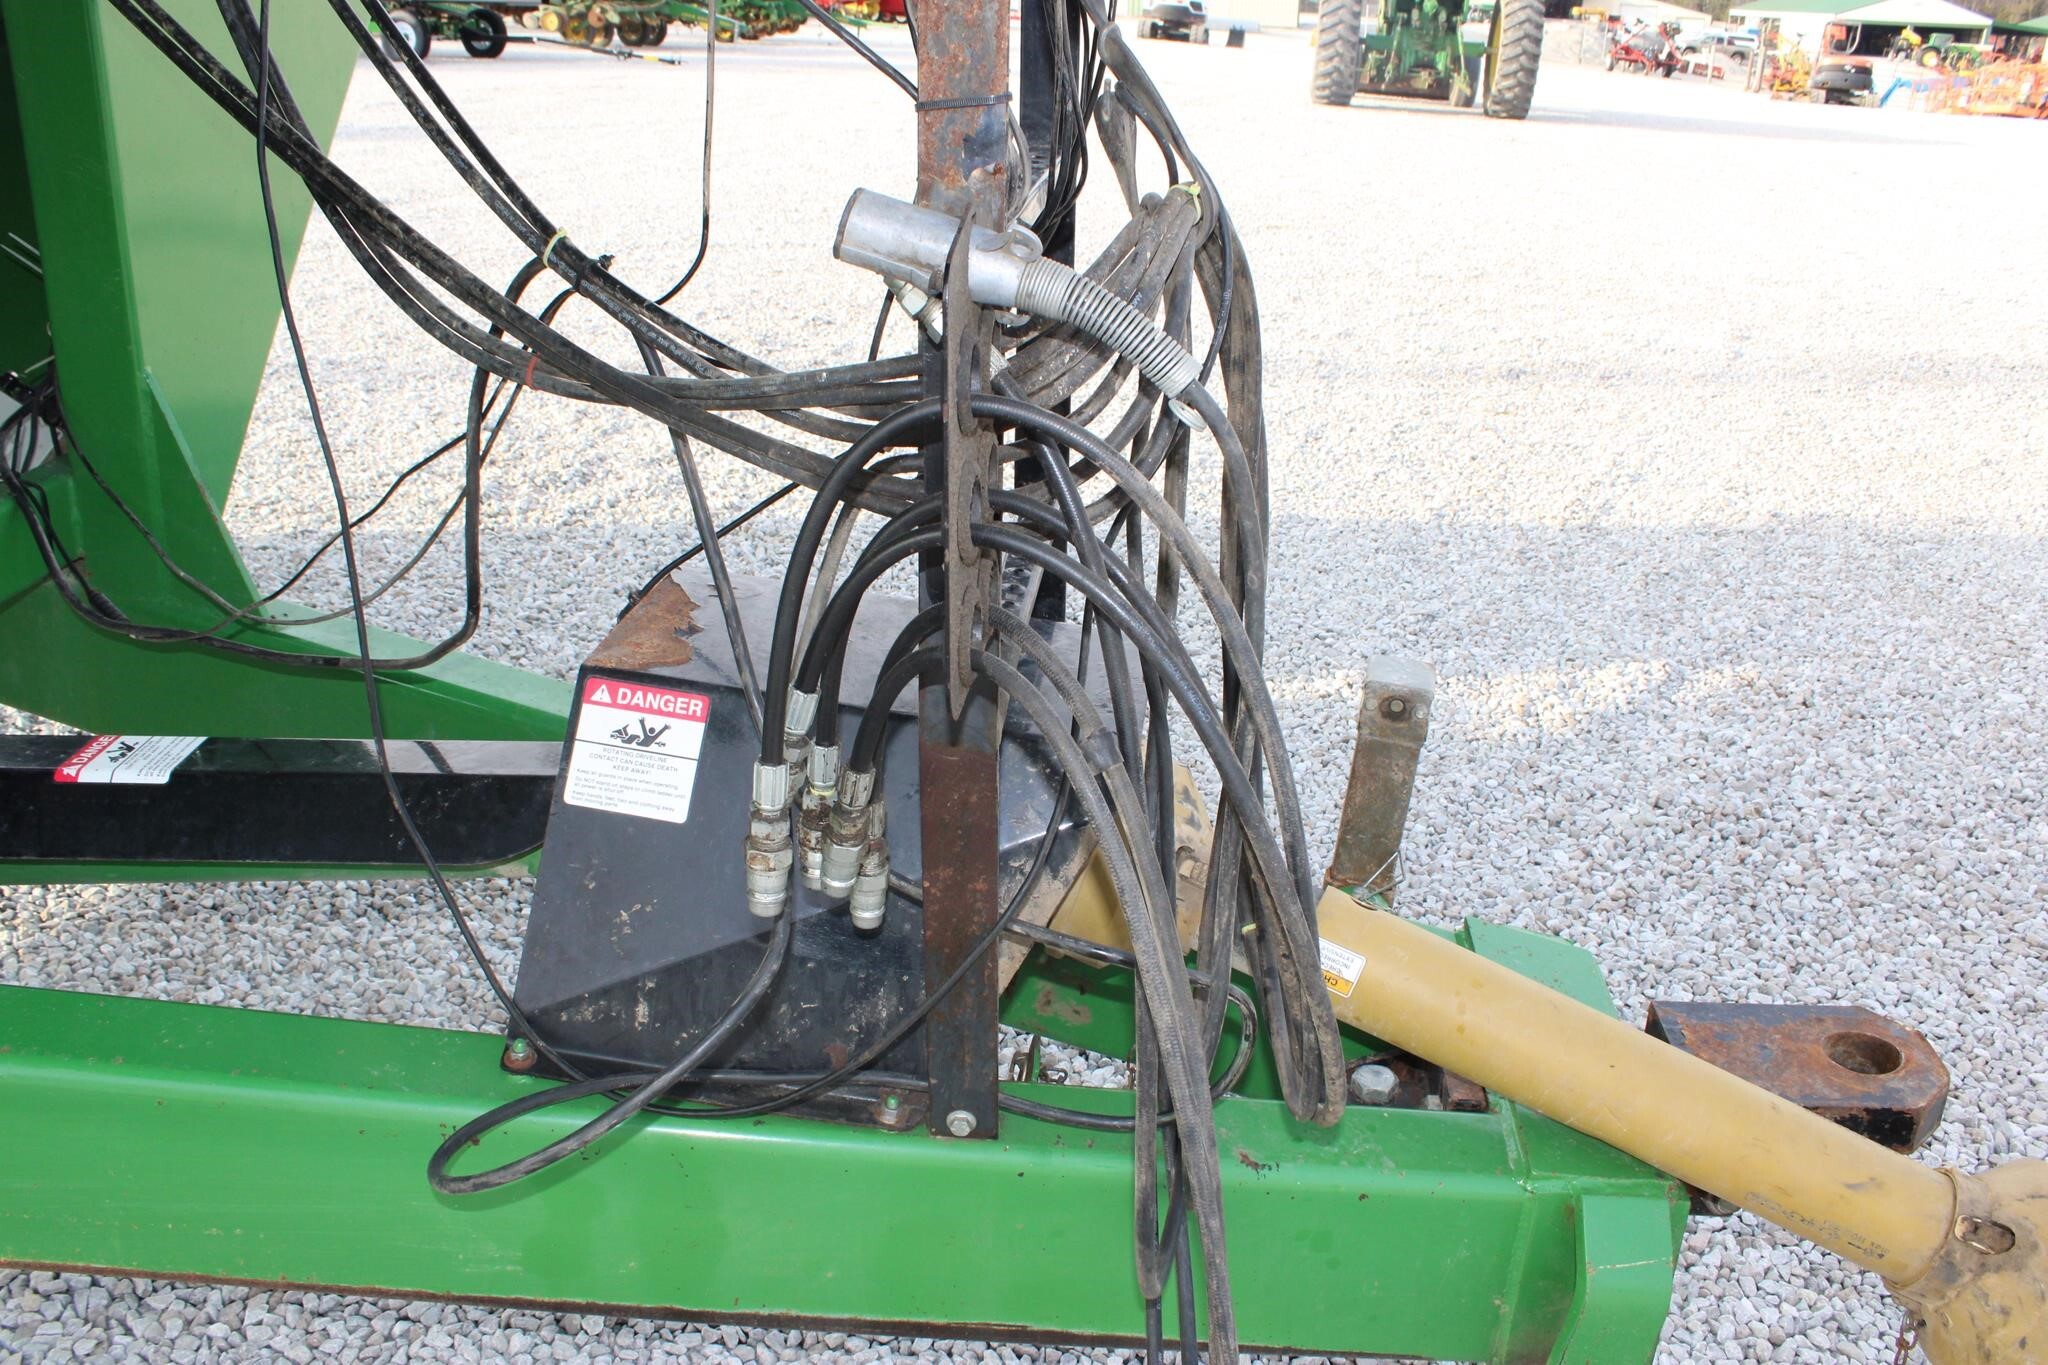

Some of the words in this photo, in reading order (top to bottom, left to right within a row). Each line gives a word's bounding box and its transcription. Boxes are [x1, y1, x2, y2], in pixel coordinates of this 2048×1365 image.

[616, 687, 703, 716] DANGER
[71, 735, 116, 765] DANGE
[602, 746, 633, 757] ROTATING
[635, 752, 667, 763] DRIVELINE
[588, 752, 618, 762] CONTACT
[619, 757, 633, 765] CAN
[634, 759, 655, 769] CAUSE
[656, 763, 678, 772] DEATH
[612, 764, 629, 772] KEEP
[576, 767, 589, 775] Keep
[598, 771, 616, 779] guards
[572, 789, 585, 797] Keep
[661, 805, 675, 813] away
[583, 797, 603, 806] moving
